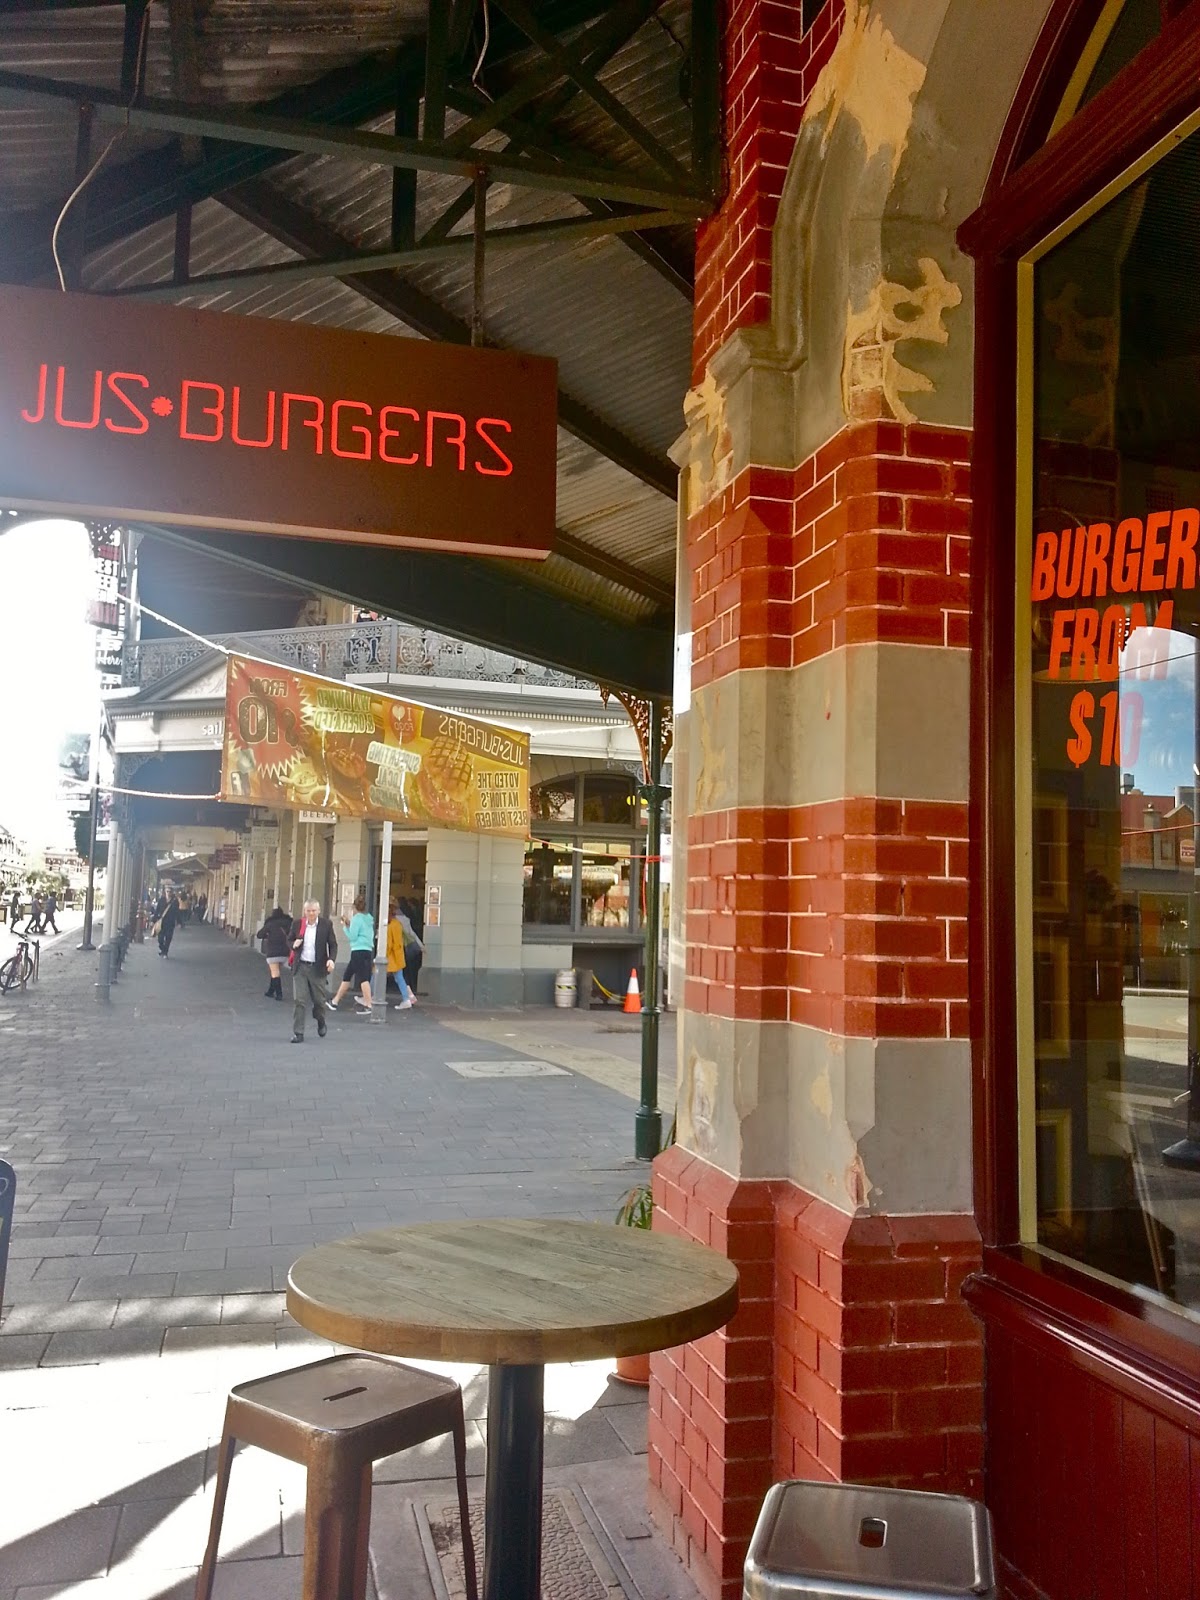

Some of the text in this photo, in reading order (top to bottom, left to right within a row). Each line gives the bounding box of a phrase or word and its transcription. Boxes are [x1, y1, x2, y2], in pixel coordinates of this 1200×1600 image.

[22, 363, 513, 476] JUS BURGERS
[1031, 507, 1200, 602] BURGER
[1048, 600, 1174, 681] FROM
[1067, 690, 1144, 768] $10
